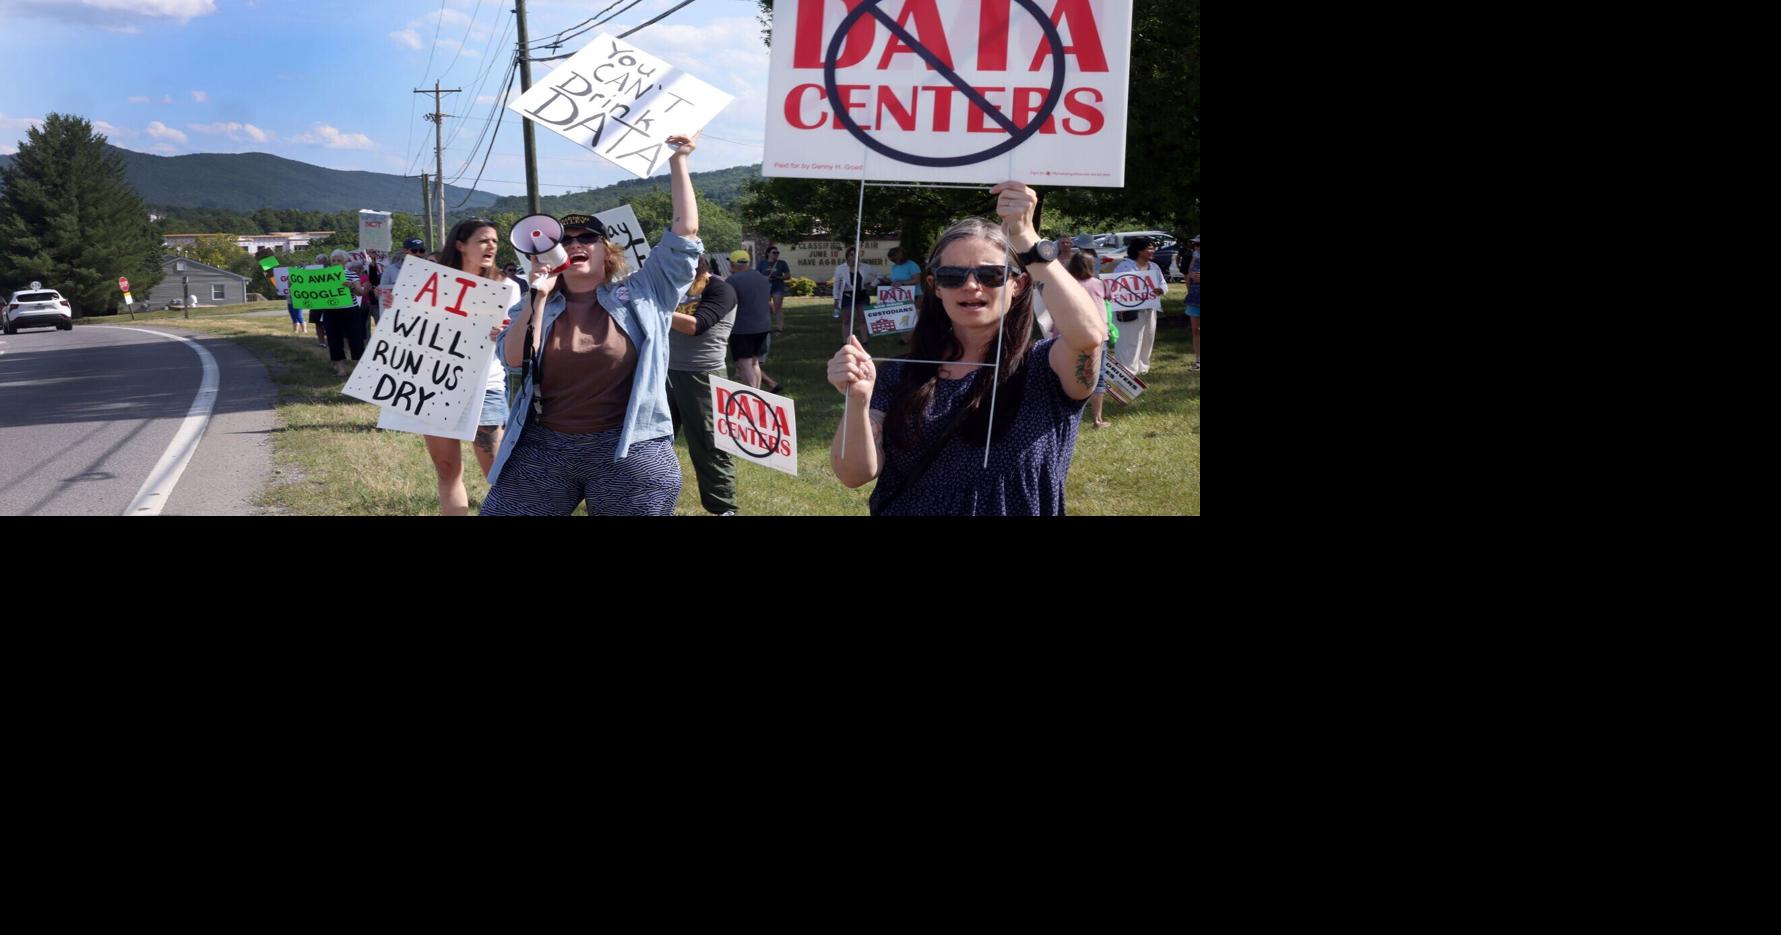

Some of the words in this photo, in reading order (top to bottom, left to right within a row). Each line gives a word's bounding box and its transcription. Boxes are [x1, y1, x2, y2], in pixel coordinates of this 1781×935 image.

[607, 41, 656, 77] You
[793, 0, 1110, 73] DATA
[556, 70, 655, 132] Drink
[593, 63, 695, 113] CAN'T
[784, 83, 1106, 136] CENTERS
[524, 86, 663, 177] DATA
[798, 258, 817, 266] HAVE
[808, 250, 828, 258] JUNE
[290, 273, 304, 284] GO
[308, 271, 342, 284] AWAY
[293, 287, 347, 300] GOOGLE
[413, 271, 477, 318] AI
[393, 309, 465, 359] WILL
[867, 306, 914, 318] CUSTODIANS
[372, 340, 424, 375] RUN
[432, 360, 464, 391] US
[1105, 362, 1138, 391] DRIVERS
[372, 373, 436, 416] DRY
[716, 387, 790, 436] DATA
[717, 419, 791, 456] CENTERS
